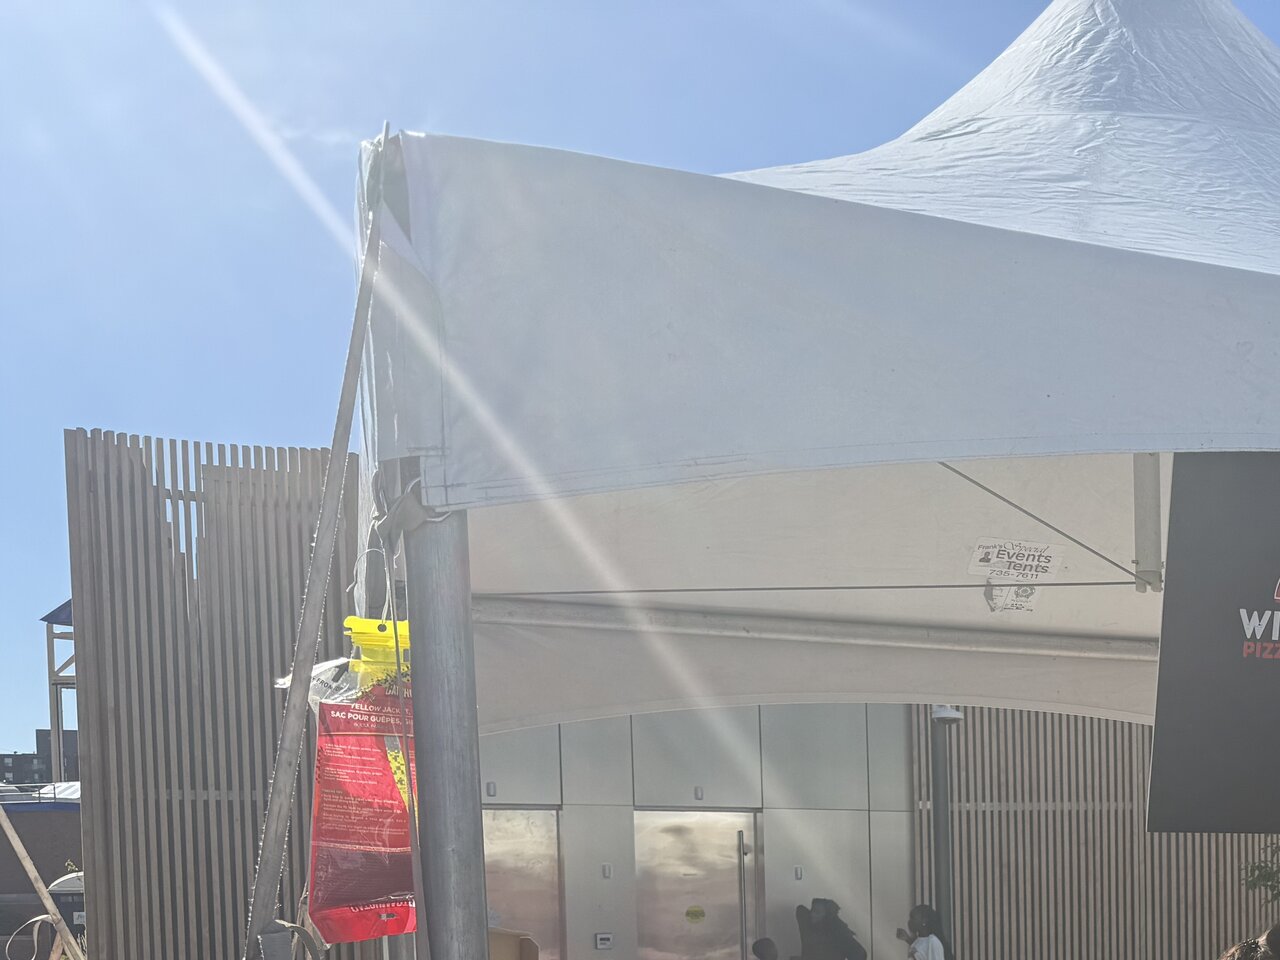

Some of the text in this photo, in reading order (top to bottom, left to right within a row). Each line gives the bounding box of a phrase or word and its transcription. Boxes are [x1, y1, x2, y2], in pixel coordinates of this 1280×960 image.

[996, 549, 1052, 564] Events
[1005, 560, 1050, 573] Tents
[989, 569, 1039, 580] 735-7611
[350, 702, 412, 715] YELLOW JACKT,
[330, 711, 346, 719] SAC
[347, 713, 369, 722] POUR
